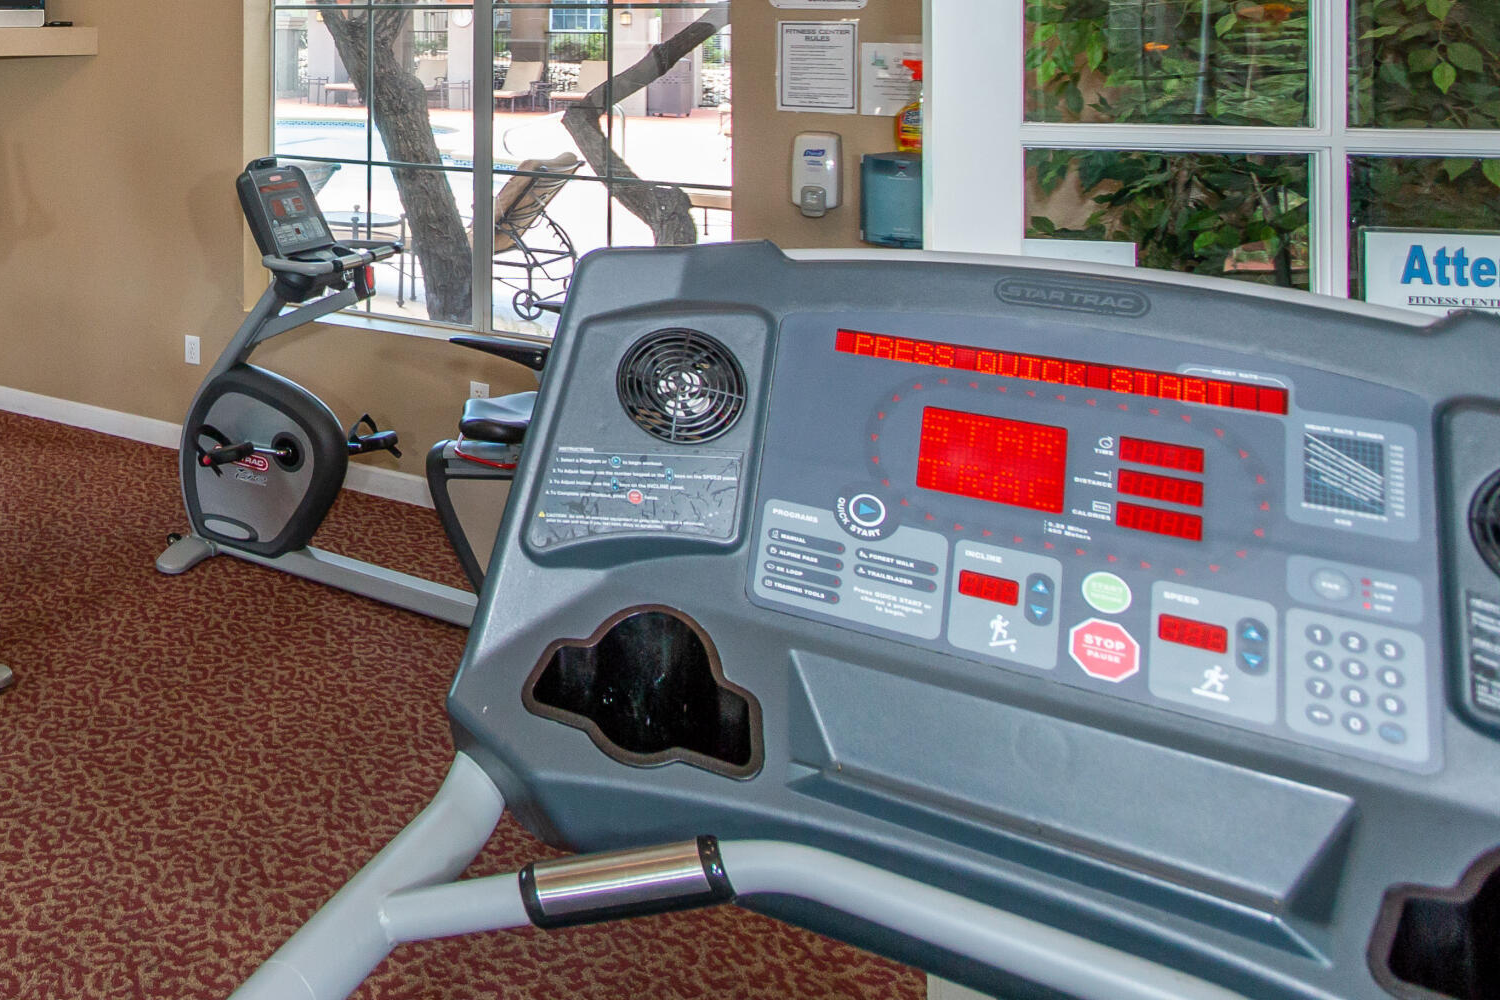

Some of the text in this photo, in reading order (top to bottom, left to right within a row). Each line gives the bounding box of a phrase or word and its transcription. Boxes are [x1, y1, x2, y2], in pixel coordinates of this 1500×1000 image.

[1401, 244, 1500, 288] Atte
[1002, 285, 1136, 309] STAR TRAC
[1408, 295, 1500, 307] FITNESS CENT
[855, 333, 1232, 407] PRESS QUICK START
[1073, 476, 1113, 489] DISTANCE
[772, 507, 819, 524] PROGRAMS
[837, 496, 882, 537] QUICK START
[1072, 508, 1112, 521] CALORIES
[780, 533, 807, 544] MANUAL
[868, 552, 915, 569] FOREST WALK
[964, 549, 1003, 564] INCLINE
[786, 568, 804, 576] LOOP
[867, 569, 914, 586] TRAILBLAZER
[774, 581, 825, 600] TRAINING TOOLS
[1163, 591, 1200, 606] SPEED
[1084, 633, 1127, 651] STOP
[1313, 629, 1322, 641] 1
[1348, 636, 1360, 649] 2
[1086, 649, 1122, 665] PAUSE
[1383, 643, 1397, 657] 3
[1313, 655, 1325, 669] 4
[1348, 662, 1361, 676] 5
[1384, 670, 1397, 685] 6
[1313, 681, 1325, 694] 7
[1348, 688, 1361, 703] 8
[1385, 697, 1398, 712] 9
[1349, 716, 1362, 731] 0
